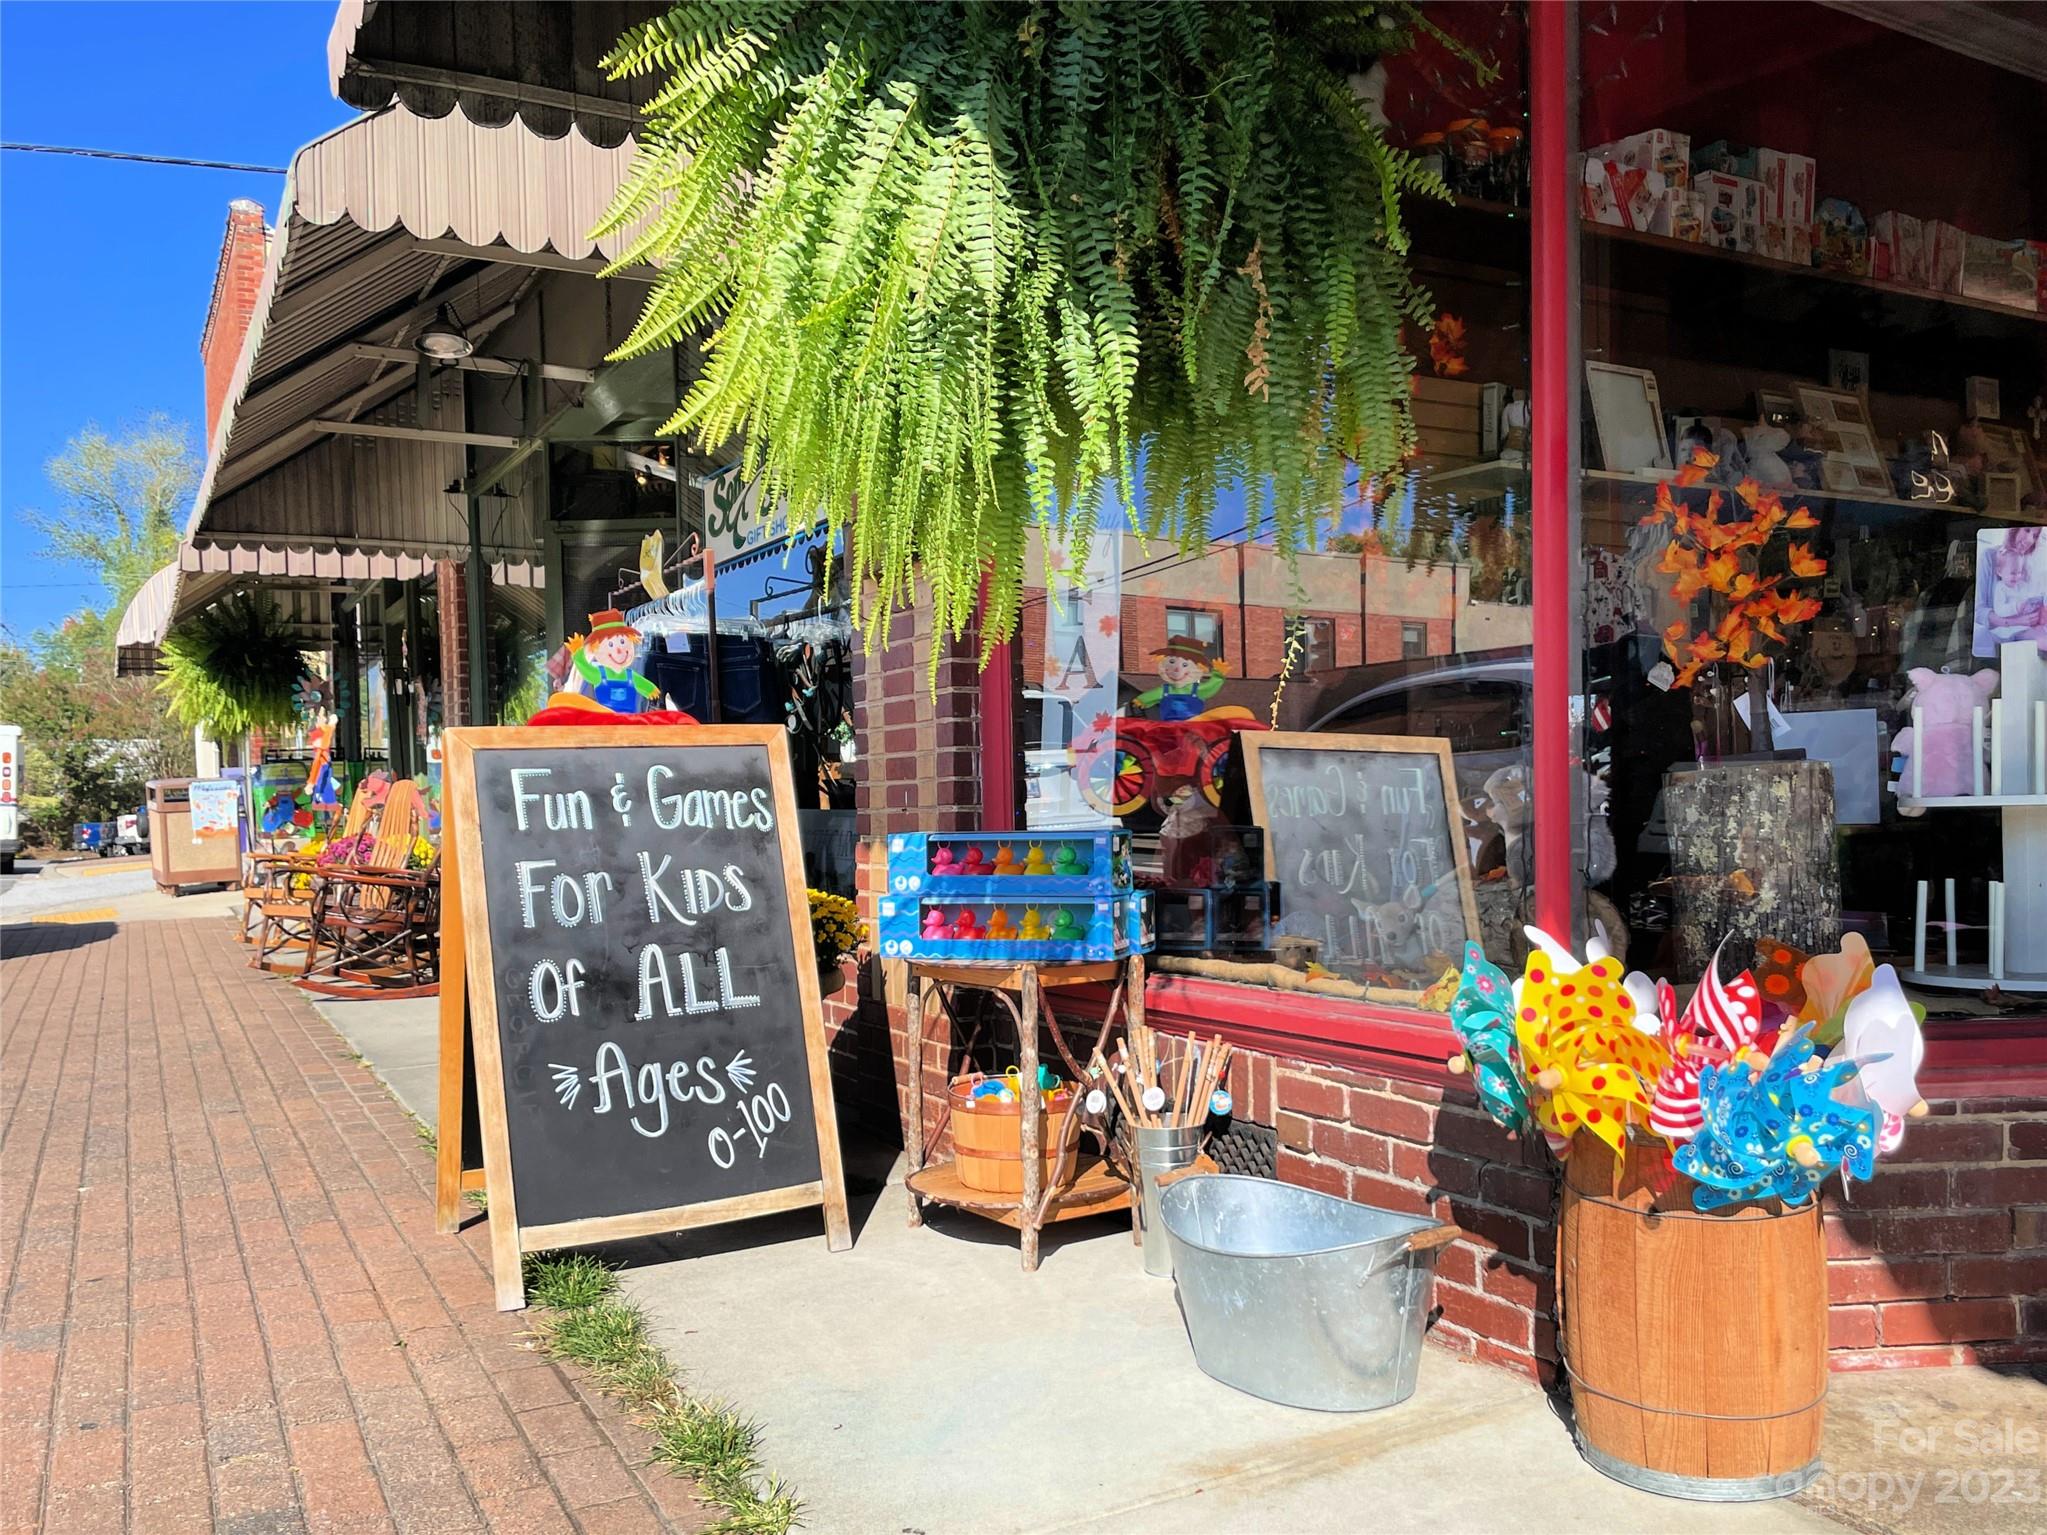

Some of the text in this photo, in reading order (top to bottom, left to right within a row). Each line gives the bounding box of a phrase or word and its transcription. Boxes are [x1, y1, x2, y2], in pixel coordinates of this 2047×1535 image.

[511, 764, 773, 832] Fun & Games
[515, 859, 614, 928] For
[528, 943, 761, 1023] Of ALL
[589, 1042, 726, 1138] Ages
[708, 1082, 791, 1168] 0-100
